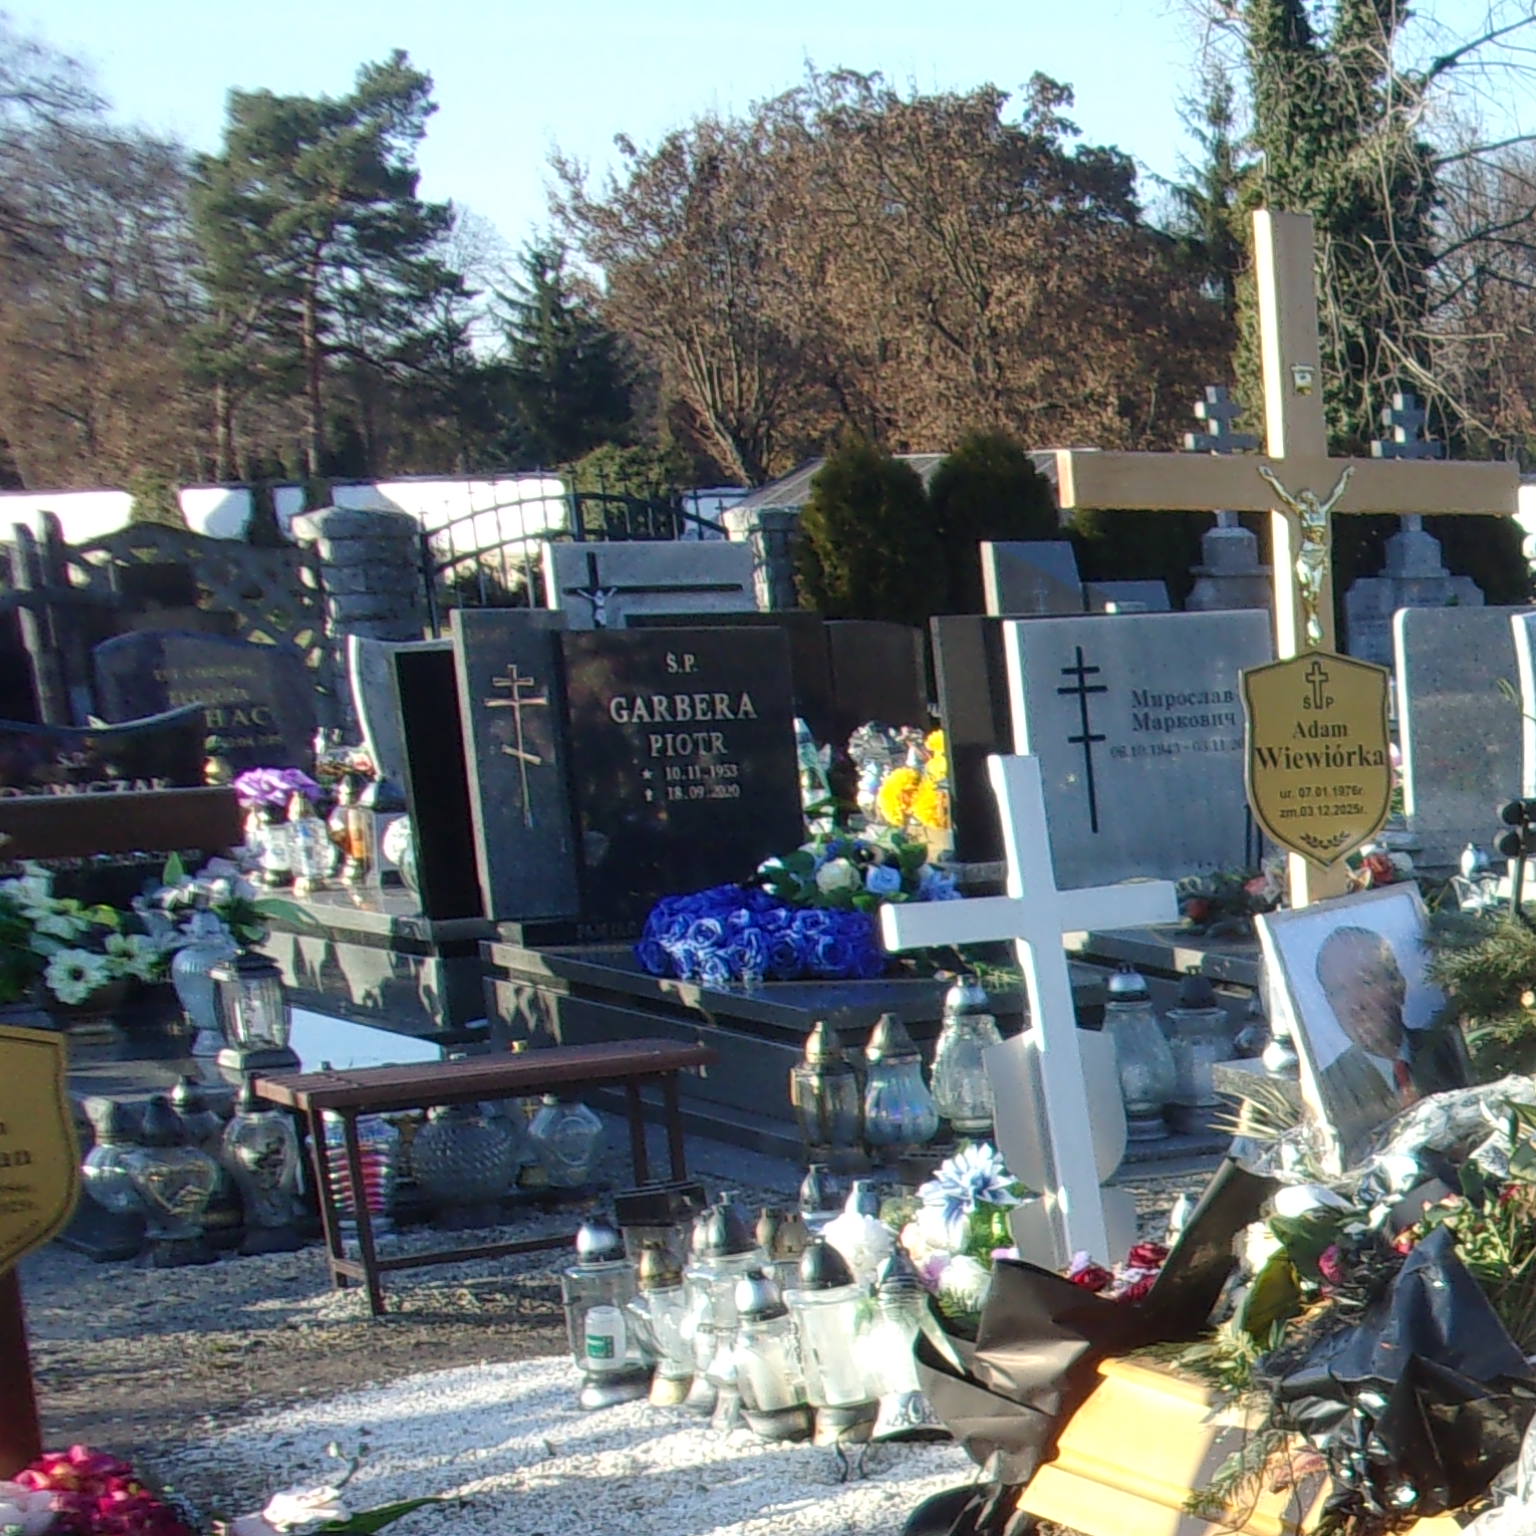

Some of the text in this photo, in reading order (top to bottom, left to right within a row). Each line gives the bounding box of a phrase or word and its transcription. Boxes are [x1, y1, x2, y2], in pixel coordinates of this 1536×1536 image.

[609, 692, 758, 724] GARBERA
[1132, 689, 1234, 711] Мирослав
[1132, 711, 1236, 733] Маркович
[1294, 719, 1348, 739] Adam
[650, 731, 728, 757] PIOTR
[1256, 743, 1386, 770] Wiewiórka
